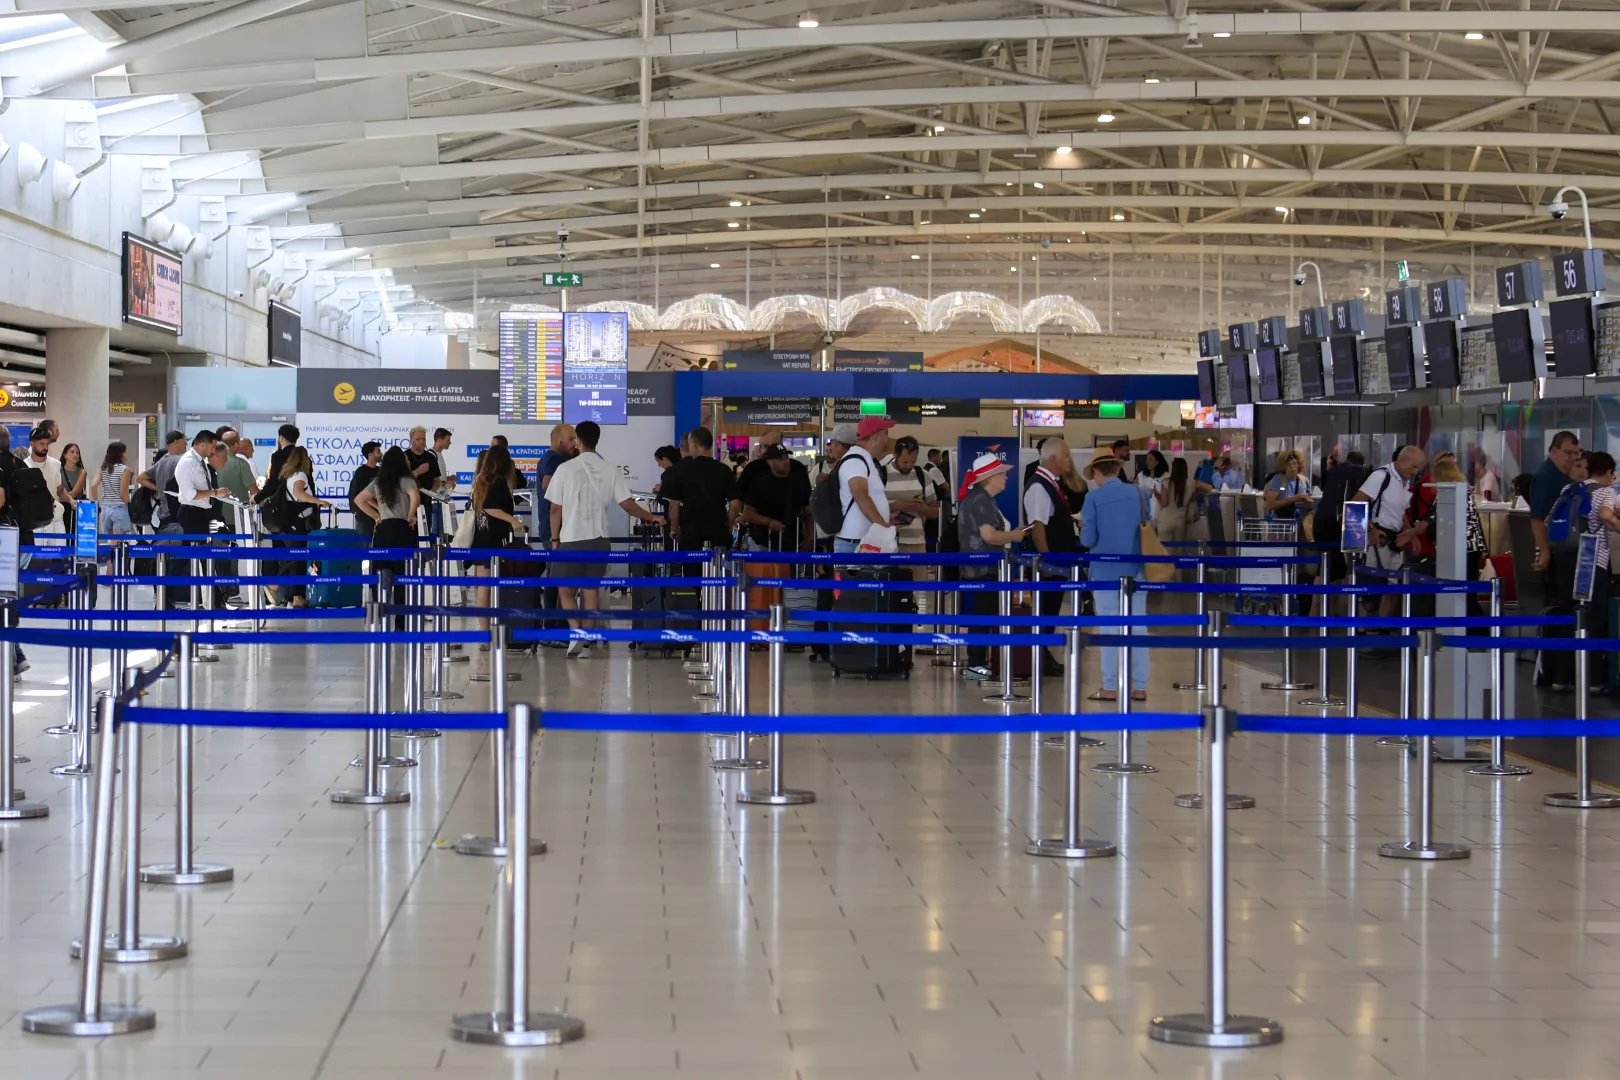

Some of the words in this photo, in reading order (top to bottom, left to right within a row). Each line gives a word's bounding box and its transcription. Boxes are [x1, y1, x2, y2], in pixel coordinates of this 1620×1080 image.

[1505, 272, 1515, 300] 57
[1563, 260, 1576, 289] 56
[1392, 295, 1400, 319] 59
[1433, 288, 1443, 313] 58
[1304, 314, 1312, 335] 61
[1337, 306, 1346, 329] 60
[1262, 322, 1270, 343] 62
[315, 470, 328, 481] ΑΙ
[515, 461, 537, 472] airpo
